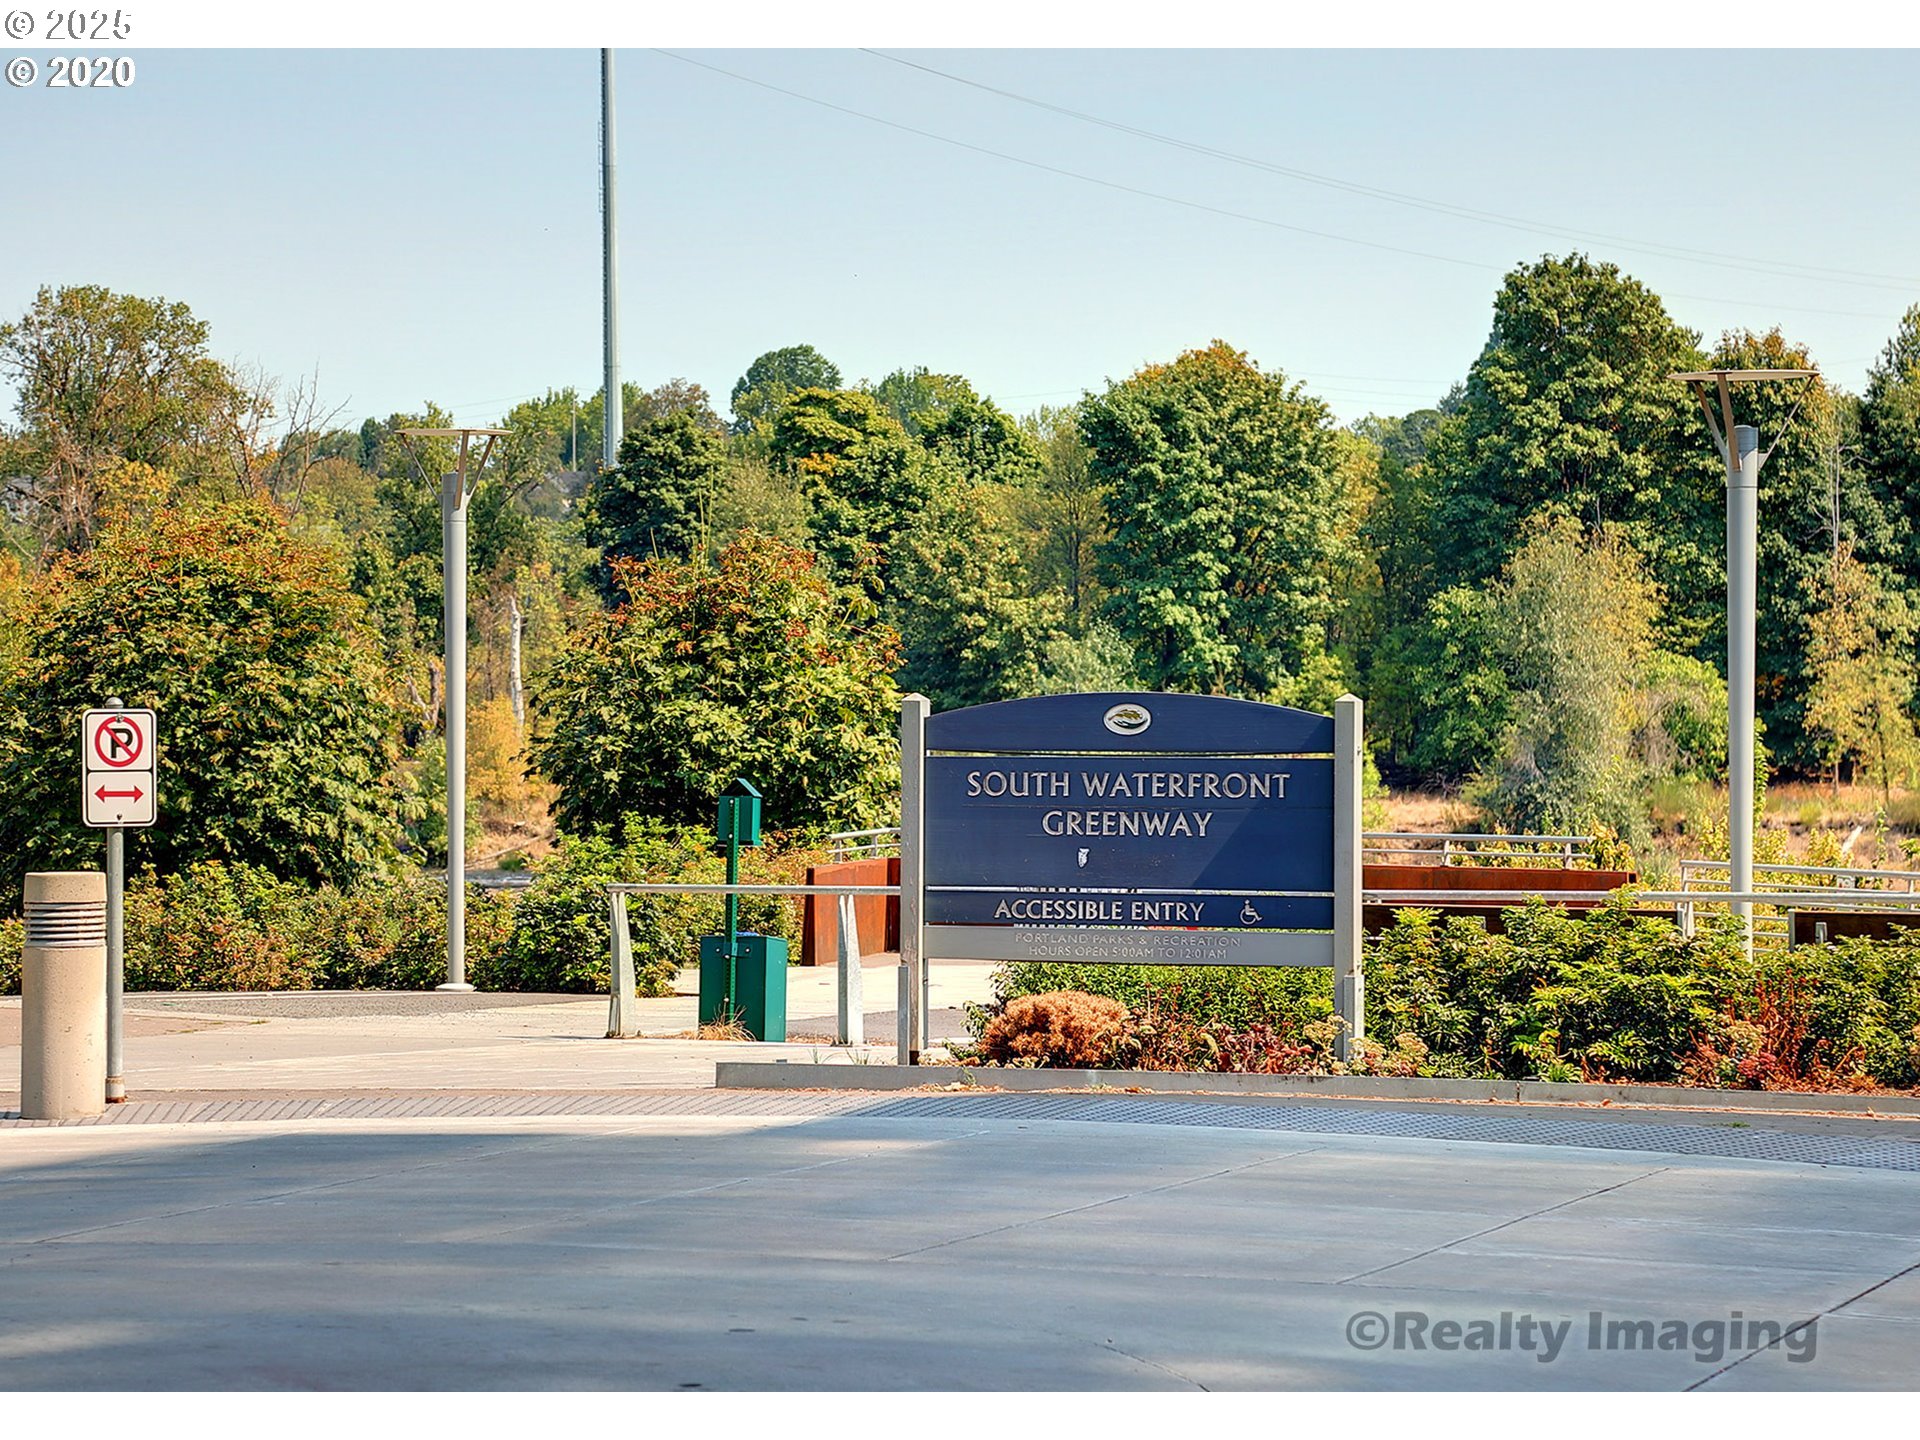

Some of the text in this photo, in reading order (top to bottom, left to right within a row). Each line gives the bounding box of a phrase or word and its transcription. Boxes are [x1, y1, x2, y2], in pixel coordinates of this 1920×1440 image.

[110, 728, 133, 758] P
[967, 771, 1291, 799] SOUTH WATERFRONT
[1042, 810, 1214, 837] GREENWAY
[994, 899, 1205, 922] ACCESSIBLE ENTRY
[1015, 932, 1089, 944] PORTLAND
[1093, 934, 1134, 945] PARKS
[1153, 935, 1241, 947] RECREATION
[1029, 945, 1227, 959] HOURS OPEN 5:00AM TO 12:01AM
